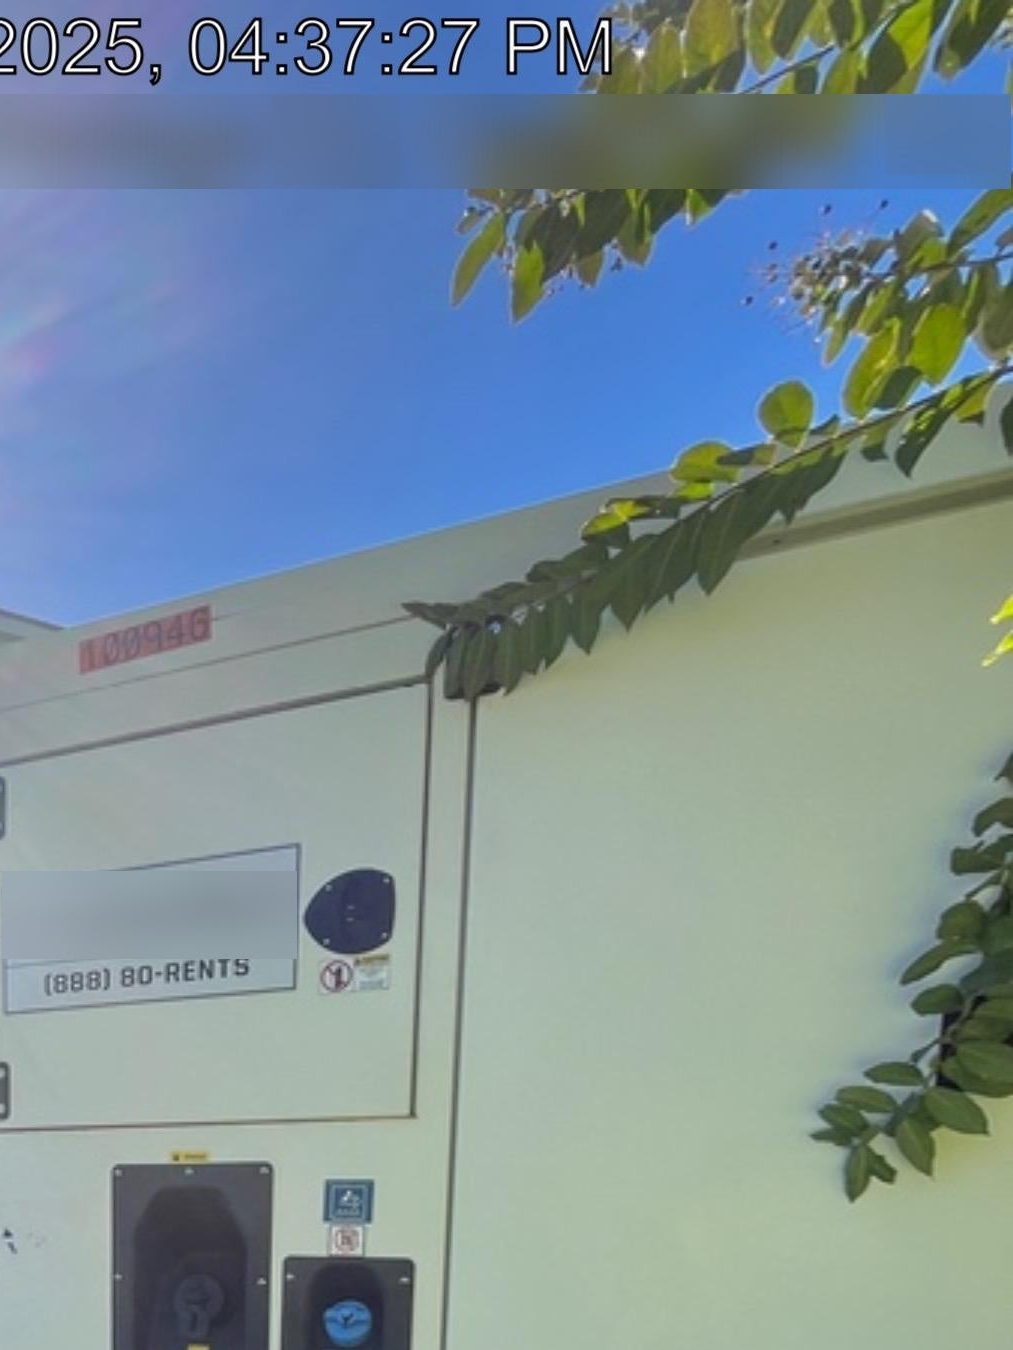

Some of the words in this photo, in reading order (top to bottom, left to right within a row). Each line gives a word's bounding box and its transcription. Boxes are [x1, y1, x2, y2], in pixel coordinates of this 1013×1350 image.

[82, 605, 212, 671] 100946
[43, 967, 111, 998] (888)
[120, 957, 251, 988] 80-RENTS
